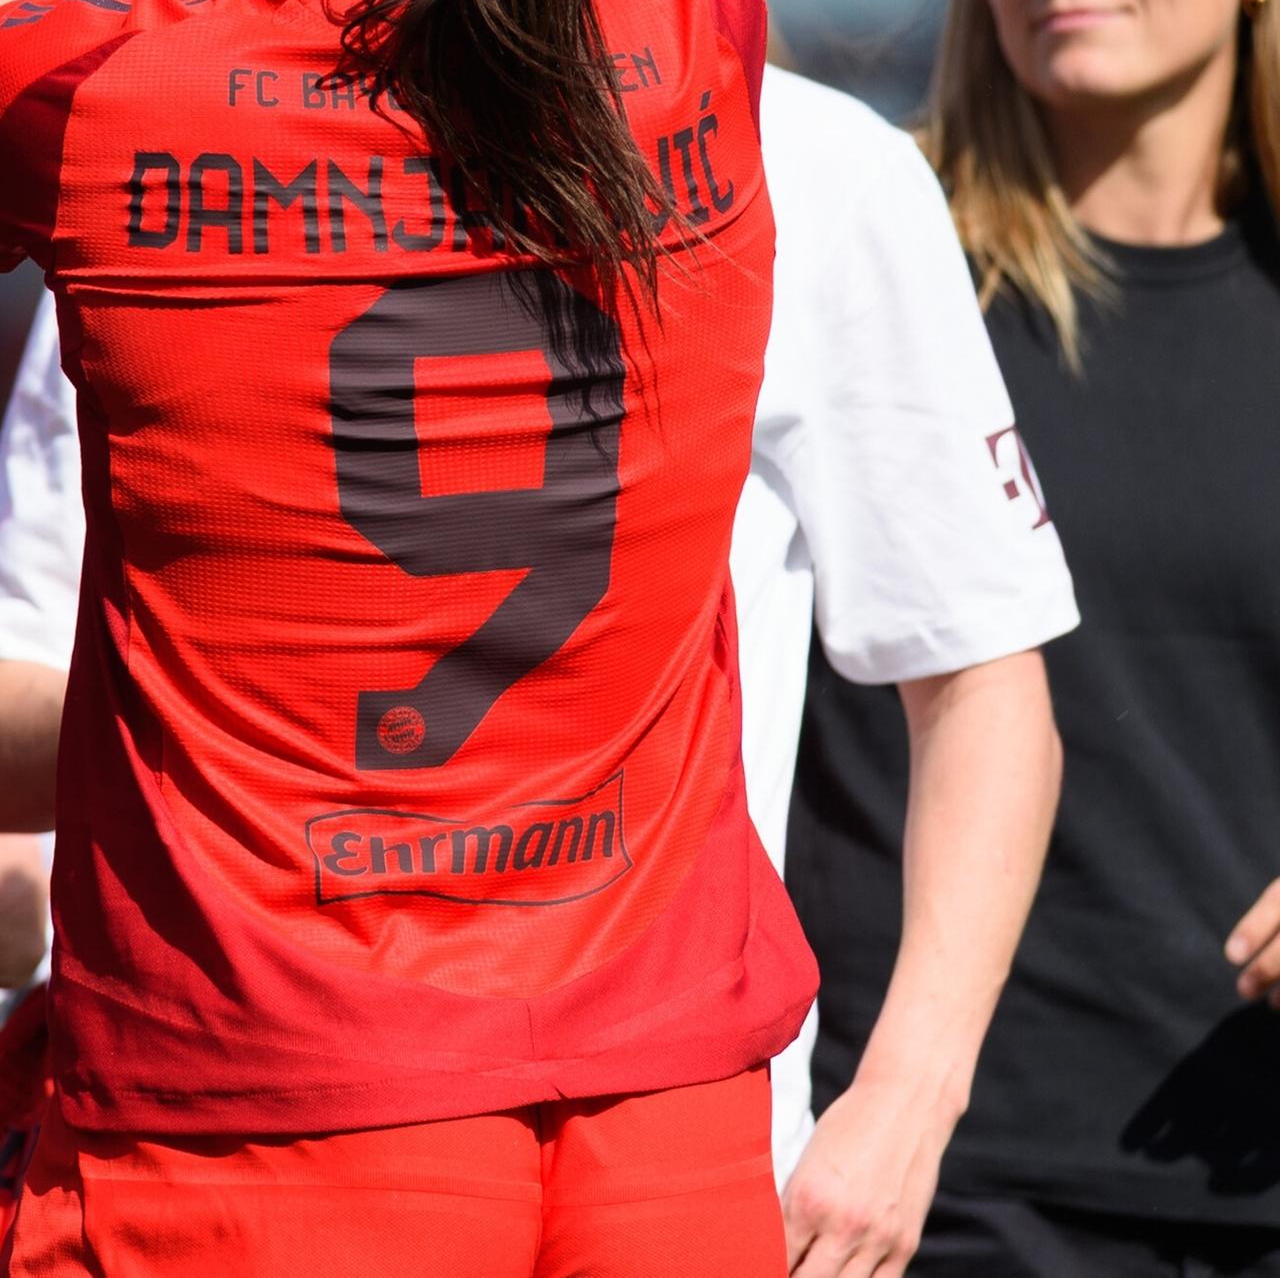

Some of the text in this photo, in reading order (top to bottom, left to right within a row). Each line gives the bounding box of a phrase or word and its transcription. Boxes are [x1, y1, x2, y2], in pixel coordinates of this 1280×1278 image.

[228, 69, 280, 108] FC
[328, 268, 627, 771] 9
[323, 808, 617, 878] Ehrmann
